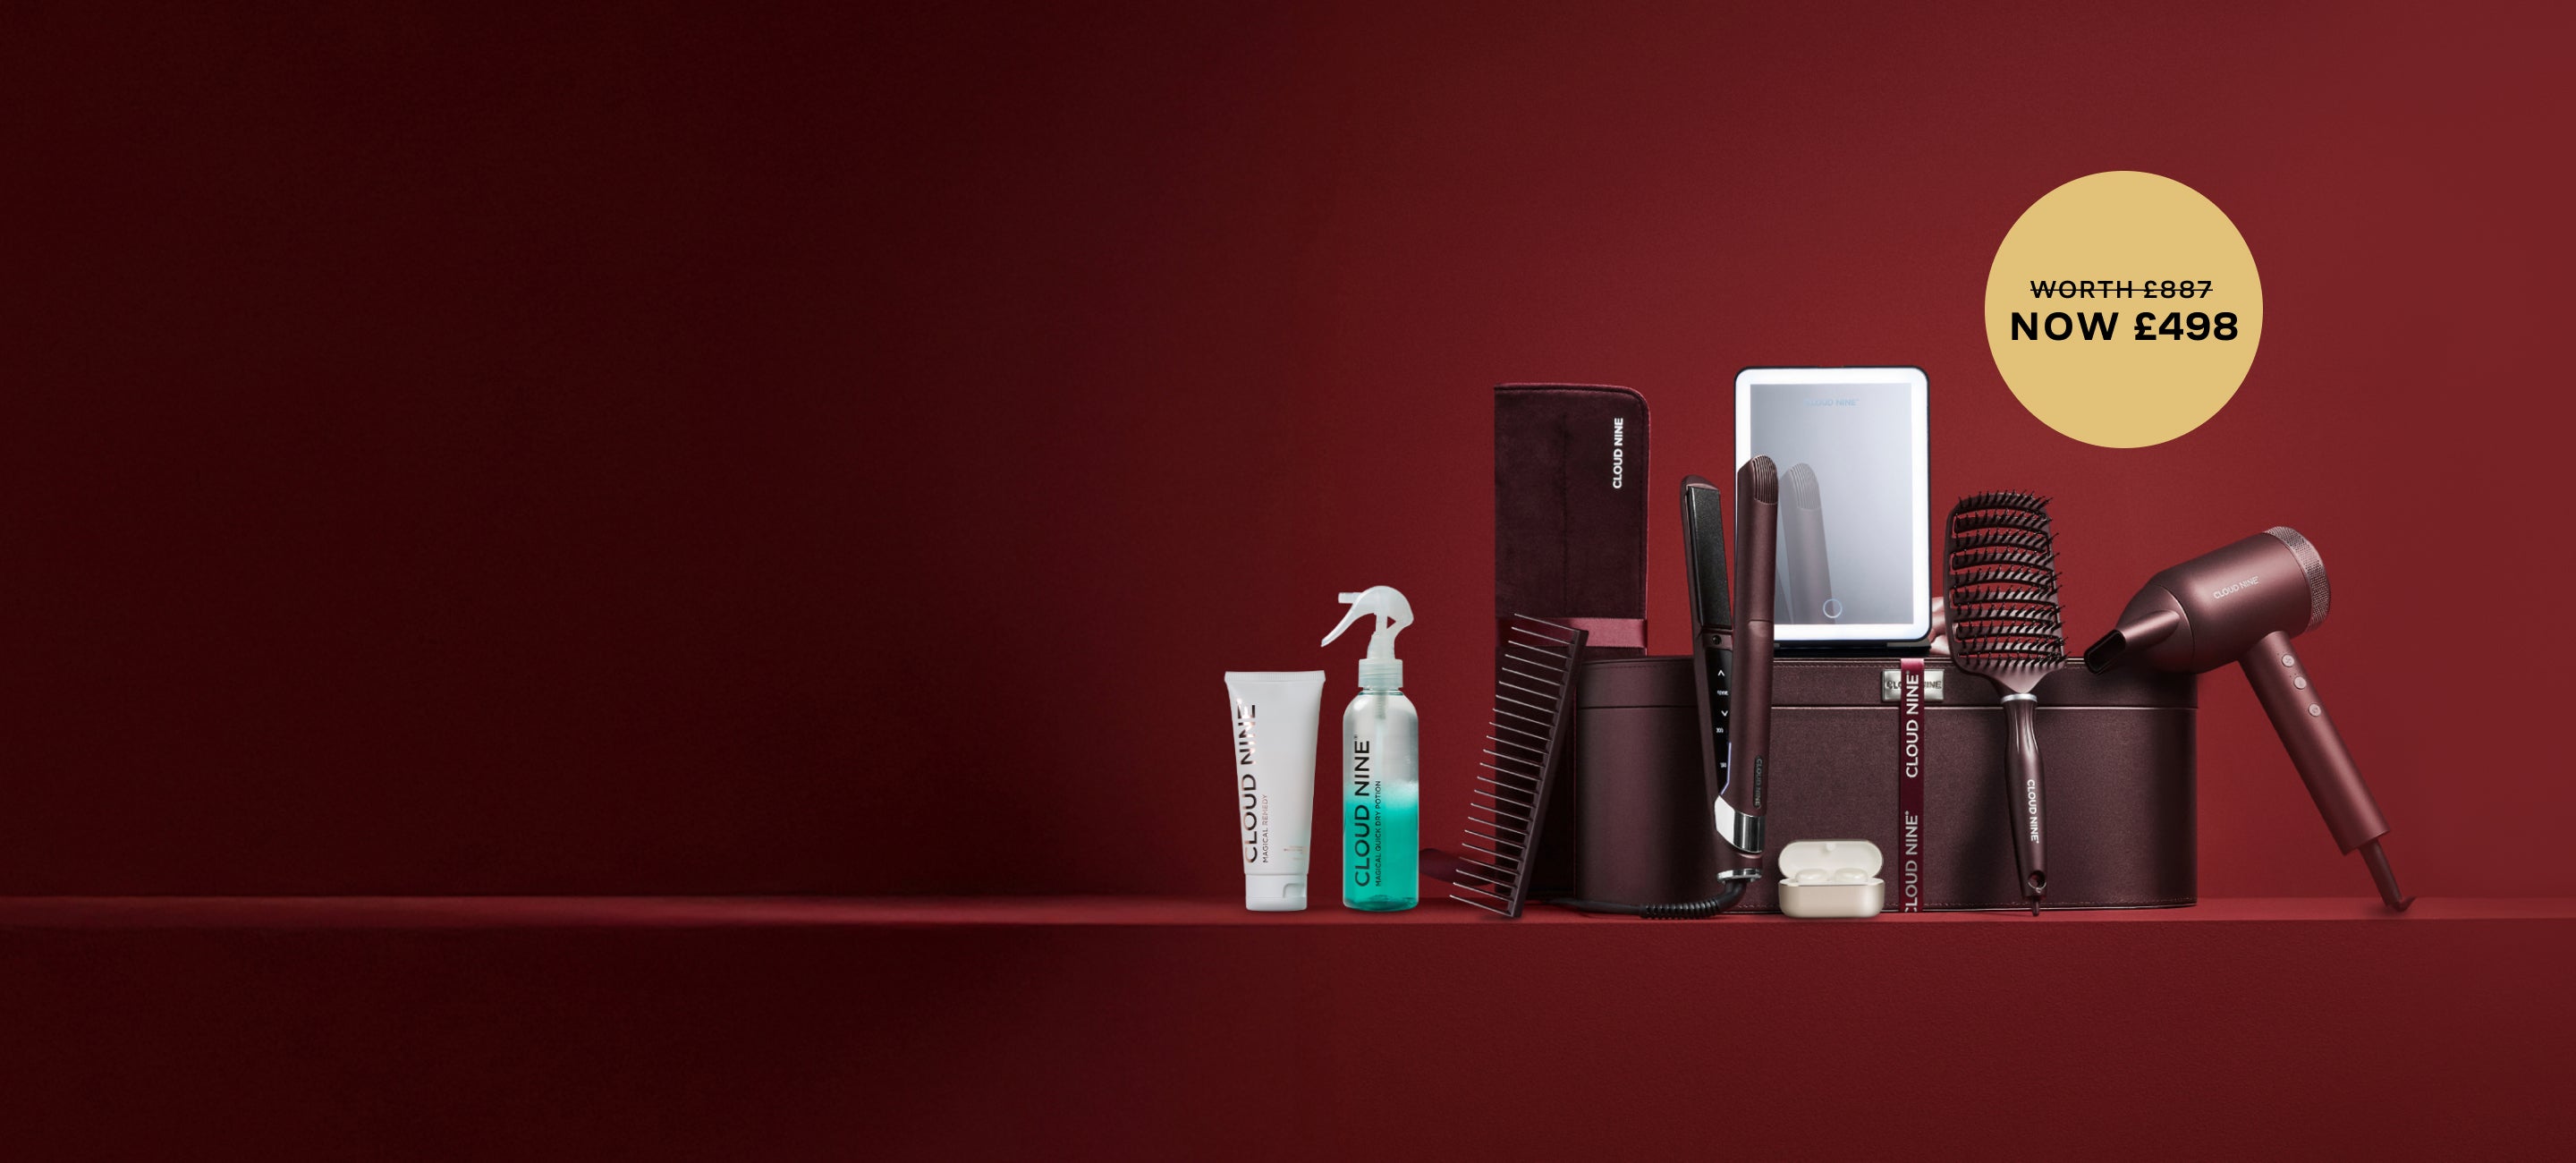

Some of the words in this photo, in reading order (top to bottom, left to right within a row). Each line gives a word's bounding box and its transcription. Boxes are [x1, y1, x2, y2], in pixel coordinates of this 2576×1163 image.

[1614, 418, 1623, 446] NINE
[1613, 448, 1623, 489] CLOUD
[2213, 584, 2240, 599] CLOUD
[2239, 575, 2259, 590] NINE
[1906, 674, 1919, 715] NINE
[1354, 741, 1370, 796] NINE
[1906, 719, 1919, 778] CLOUD
[2027, 779, 2038, 815] CLOUD
[1241, 774, 1258, 863] CLOUD
[1905, 815, 1919, 855] NINE
[2029, 816, 2039, 842] NINE
[1354, 804, 1370, 887] CLOUD
